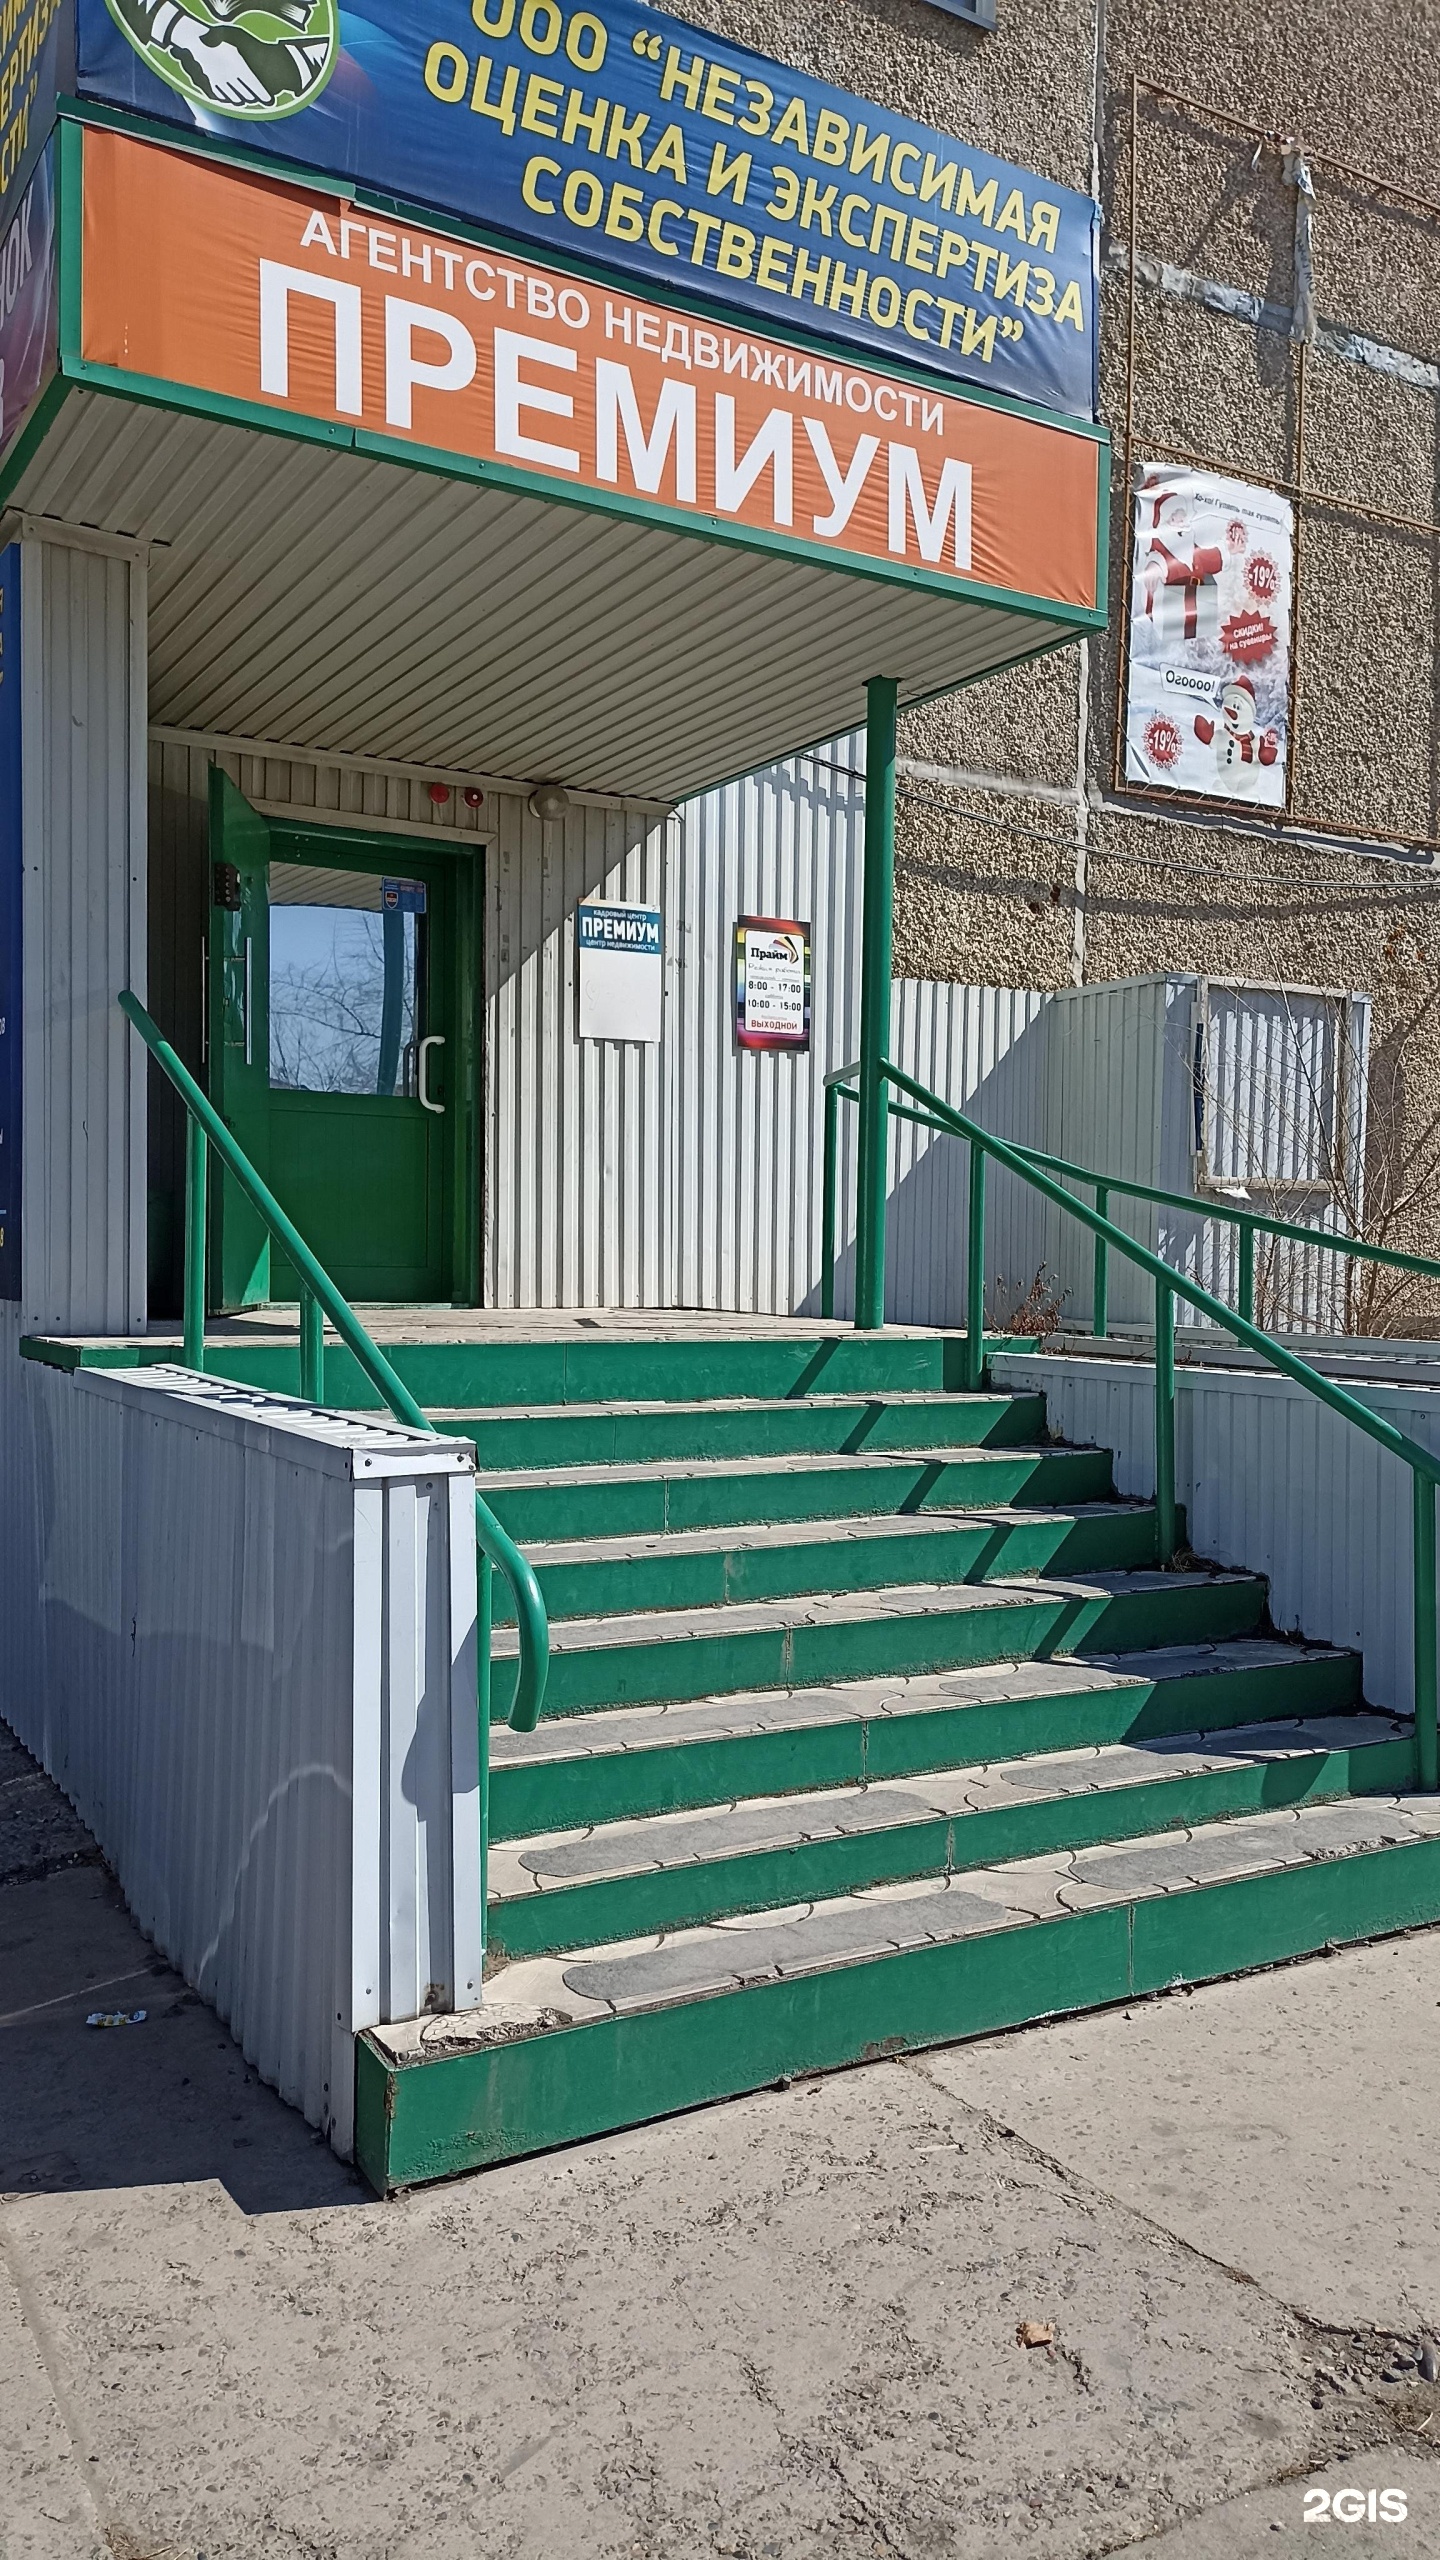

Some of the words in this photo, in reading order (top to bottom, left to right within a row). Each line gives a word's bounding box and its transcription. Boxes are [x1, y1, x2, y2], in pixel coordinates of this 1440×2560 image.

[471, 0, 608, 72] ООО
[423, 41, 688, 185] ОЦЕНКА
[705, 141, 753, 206] И
[766, 166, 1085, 332] ЭКСПЕРТИЗА
[300, 210, 590, 329] АГЕНТСТВО
[605, 302, 945, 436] НЕДВИЖИМОСТИ
[259, 257, 973, 571] ПРЕМИУМ
[1249, 565, 1275, 590] -19%
[1149, 730, 1176, 753] -19%
[593, 909, 626, 918] кадровый
[627, 912, 647, 921] центр
[582, 916, 659, 944] ПРЕМИУМ
[586, 940, 606, 948] центр
[607, 941, 655, 951] недвижимости
[750, 947, 788, 960] Прайм
[748, 981, 768, 991] 8:00
[778, 983, 801, 994] 17:00
[748, 999, 770, 1009] 10:00
[780, 1002, 801, 1012] 15:00
[751, 1020, 798, 1031] ВЫХОДНОЙ
